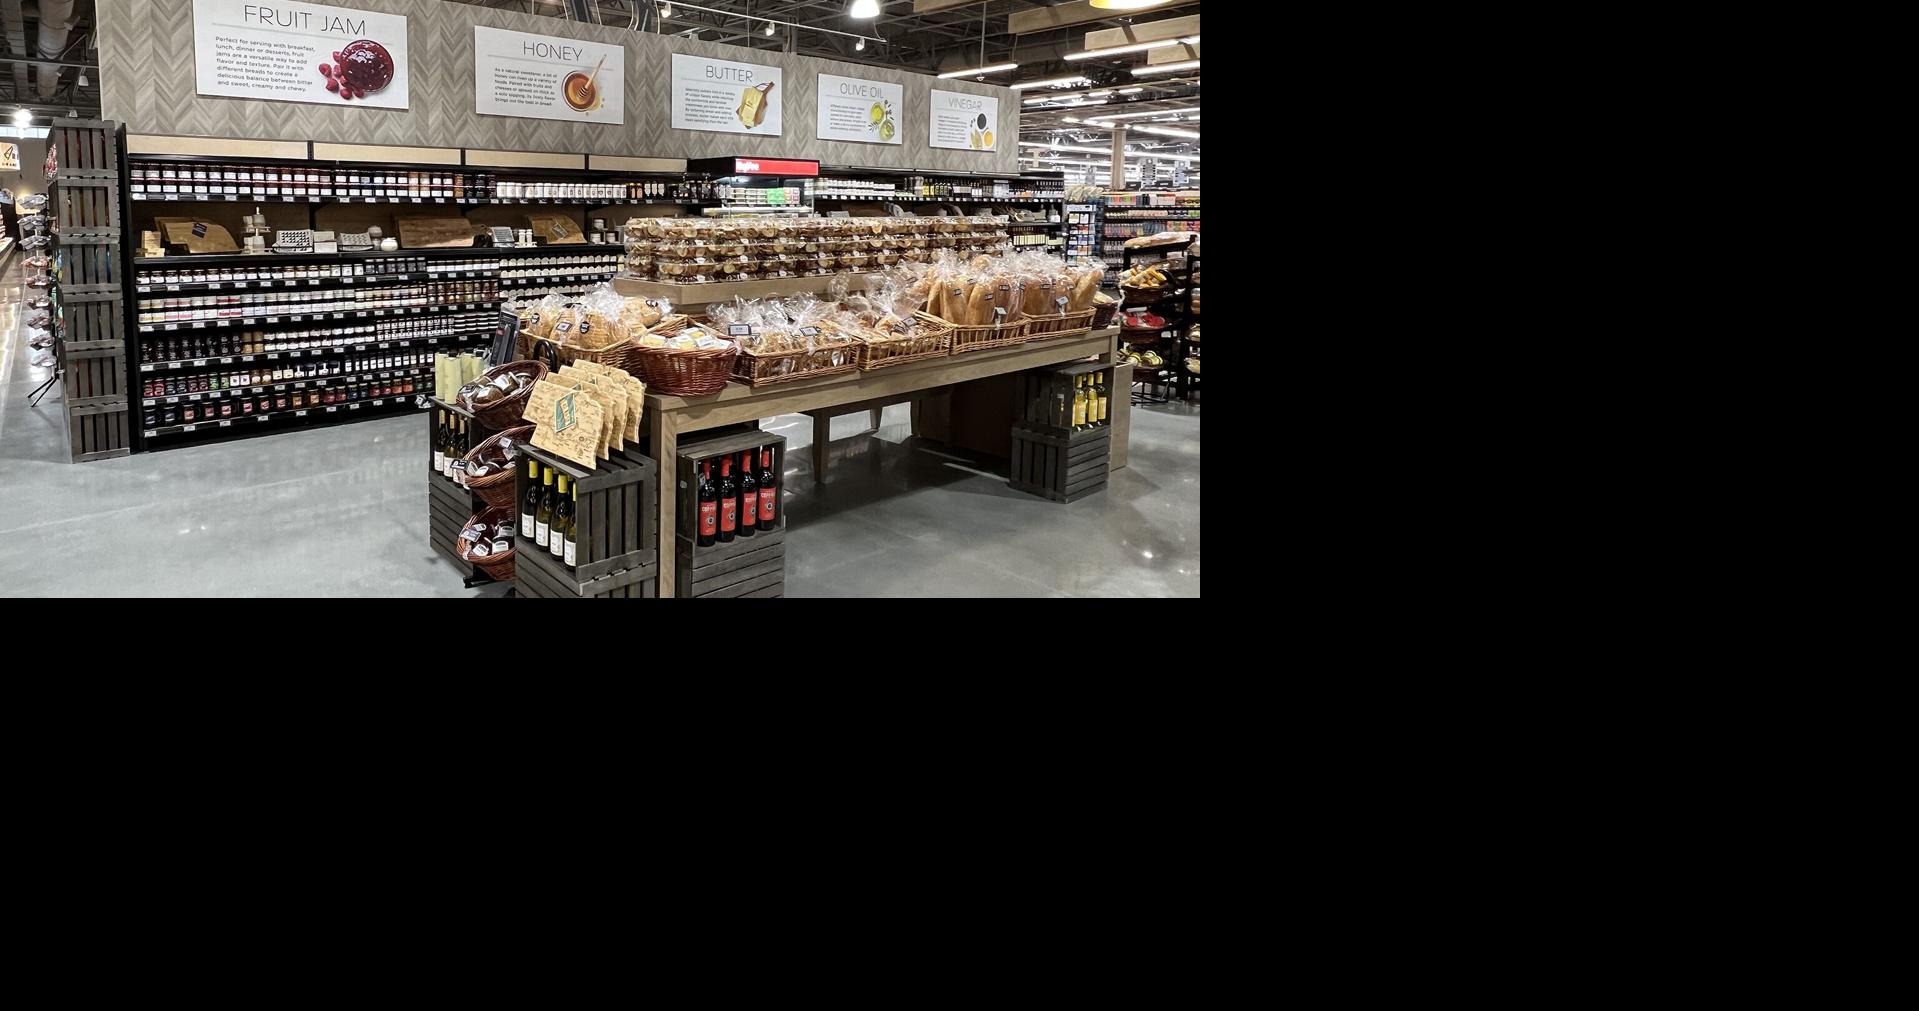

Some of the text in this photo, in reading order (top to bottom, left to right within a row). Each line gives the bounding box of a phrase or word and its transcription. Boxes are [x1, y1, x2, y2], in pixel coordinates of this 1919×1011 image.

[244, 5, 365, 36] FRUIT JAM
[523, 41, 582, 61] HONEY
[706, 66, 753, 82] BUTTER
[840, 82, 883, 98] OLIVE OIL
[948, 97, 982, 110] VINEGAR
